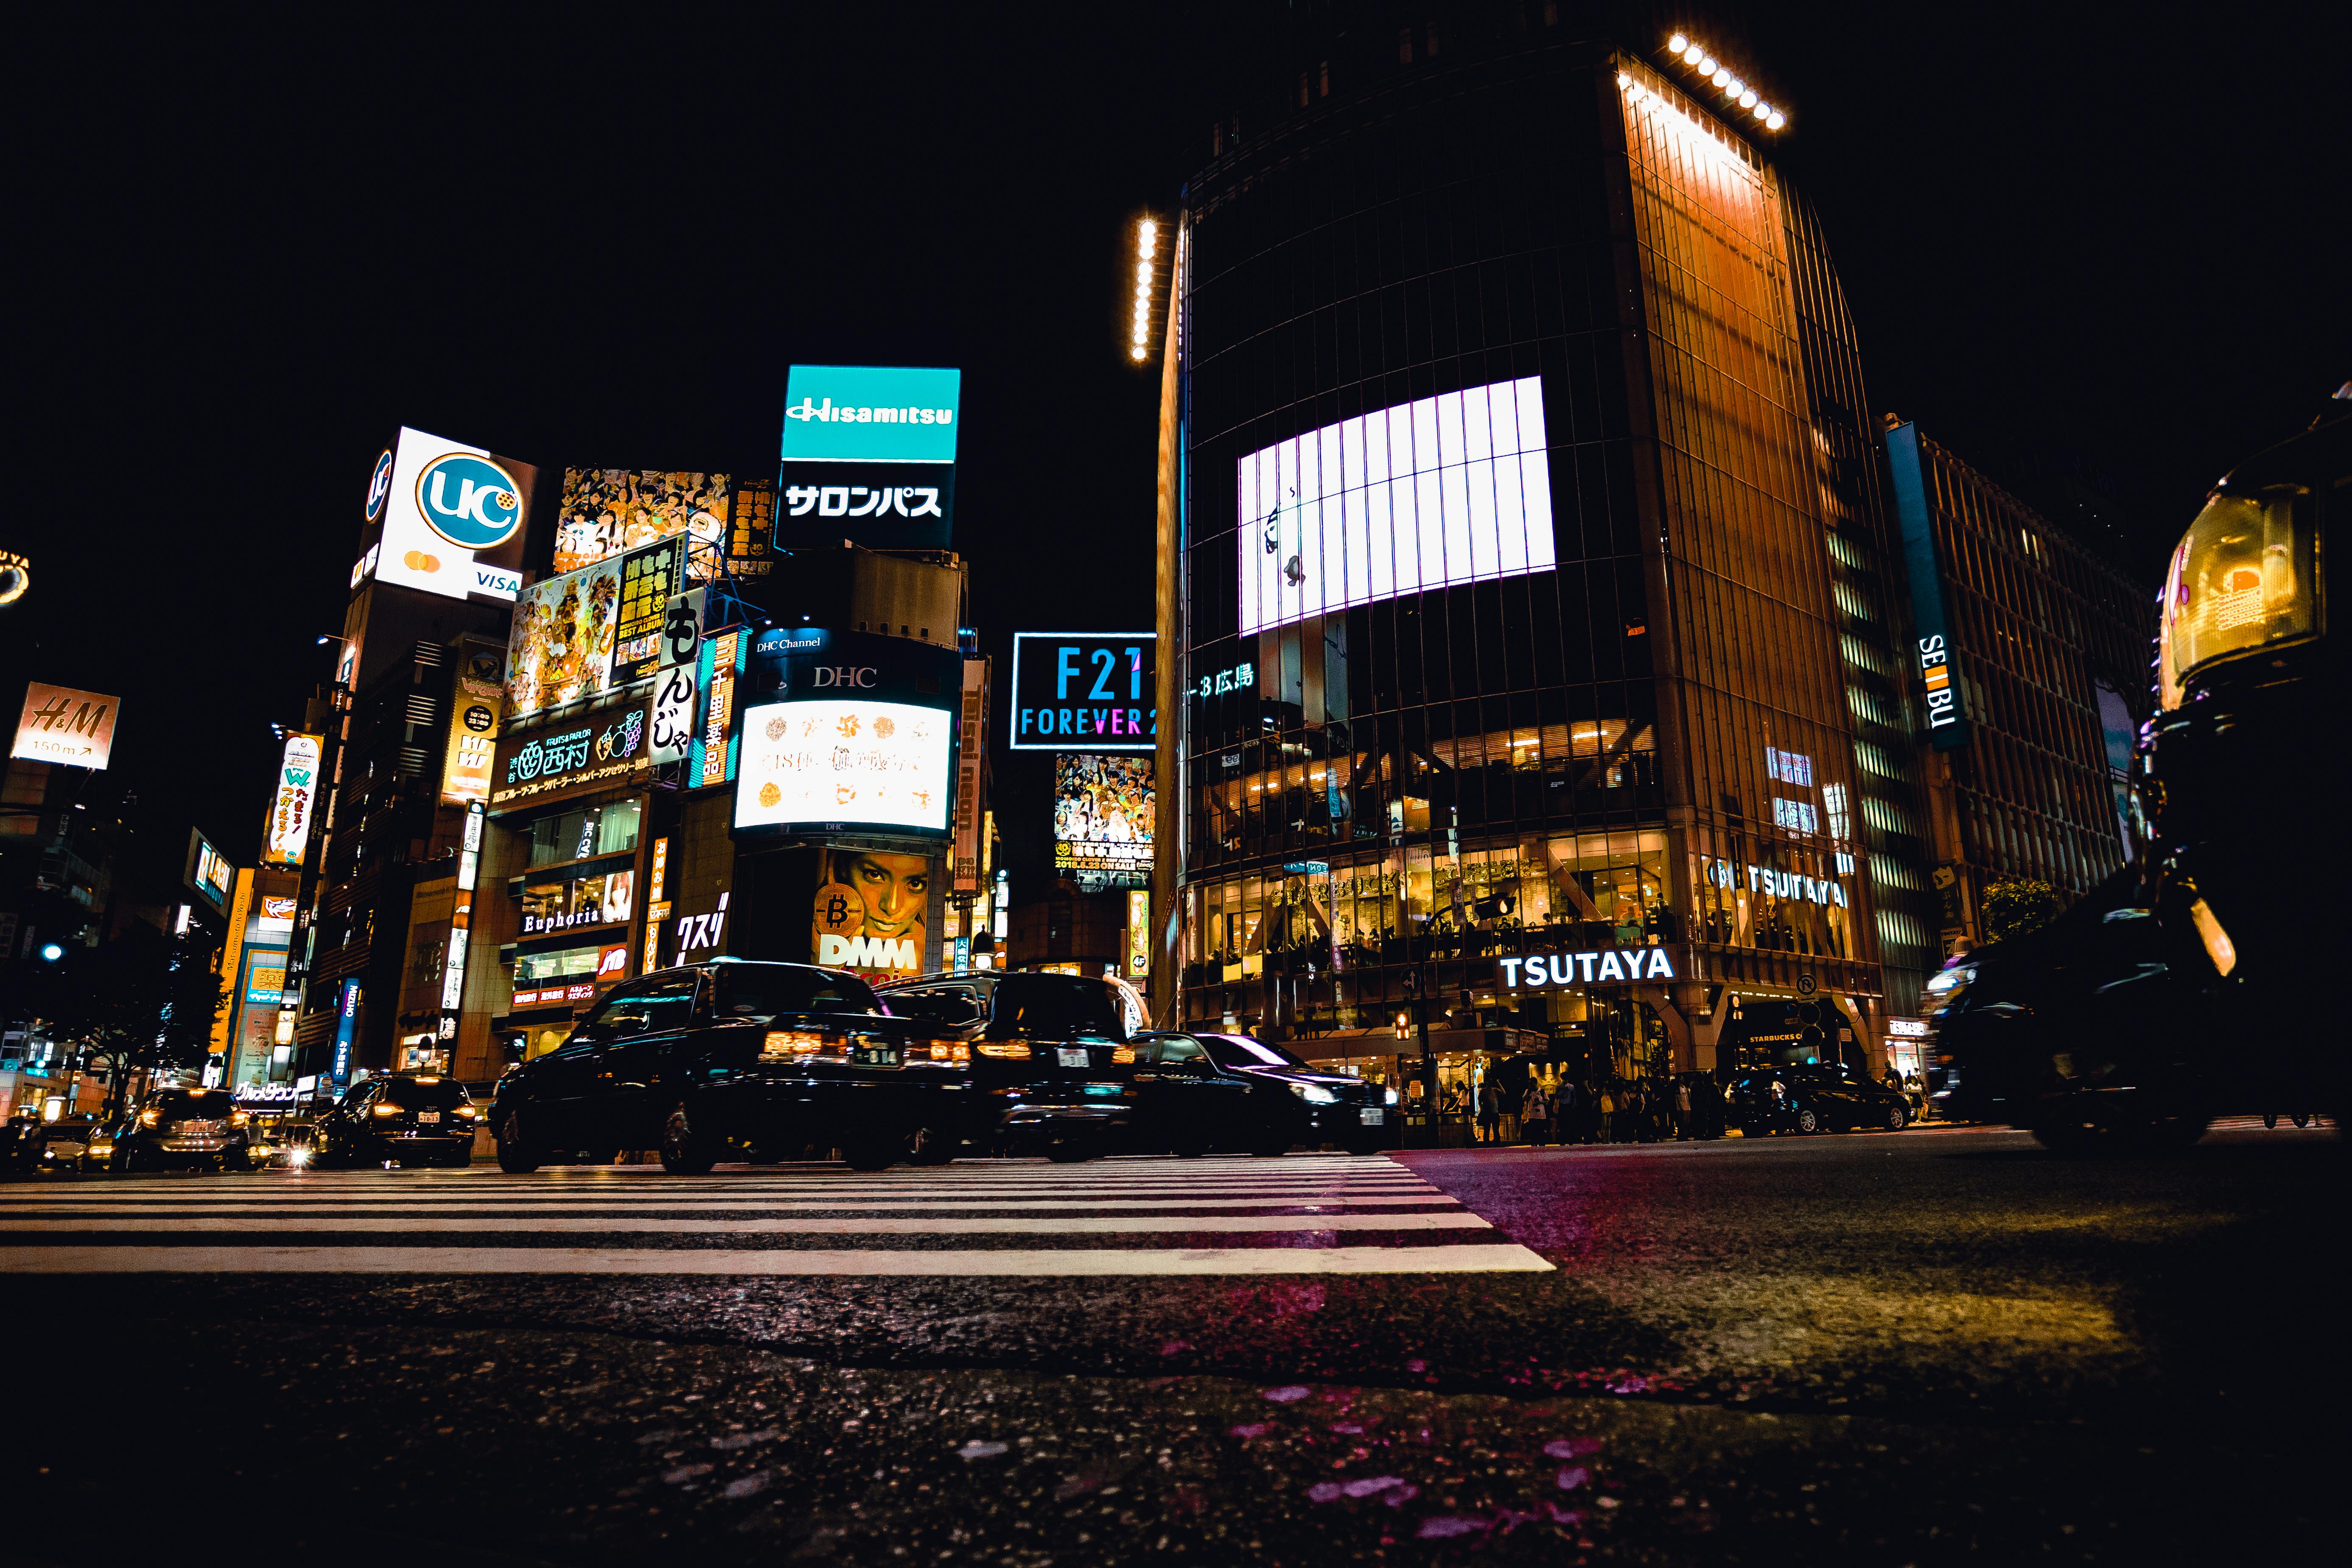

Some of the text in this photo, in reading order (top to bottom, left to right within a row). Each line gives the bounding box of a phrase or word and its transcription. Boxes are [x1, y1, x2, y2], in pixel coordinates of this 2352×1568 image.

[786, 397, 952, 424] Hisamitsu
[430, 470, 512, 529] UC
[786, 486, 941, 518] サロンパス
[477, 571, 518, 593] VISA
[619, 627, 636, 639] BEST
[757, 638, 820, 653] DHC Channel
[653, 596, 699, 755] もんじゃ
[813, 667, 877, 688] DHC
[1057, 647, 1141, 700] F21
[1919, 635, 1955, 730] SEIBU
[29, 695, 108, 739] H&M
[703, 639, 731, 776] 三千里薬品
[1021, 708, 1141, 734] FOREVER
[543, 740, 590, 775] 西村
[958, 766, 974, 831] neon
[1114, 862, 1136, 871] SALE
[1748, 865, 1848, 908] TSUTAYA
[524, 908, 599, 933] Euphoria
[597, 948, 627, 976] JTB
[819, 934, 917, 970] DMM
[1134, 957, 1145, 966] 4F
[1500, 949, 1675, 988] TSUTAYA
[345, 985, 358, 1017] MIZUHO
[1750, 1033, 1795, 1043] STARBUCKS
[235, 1080, 297, 1101] グルメタウン
